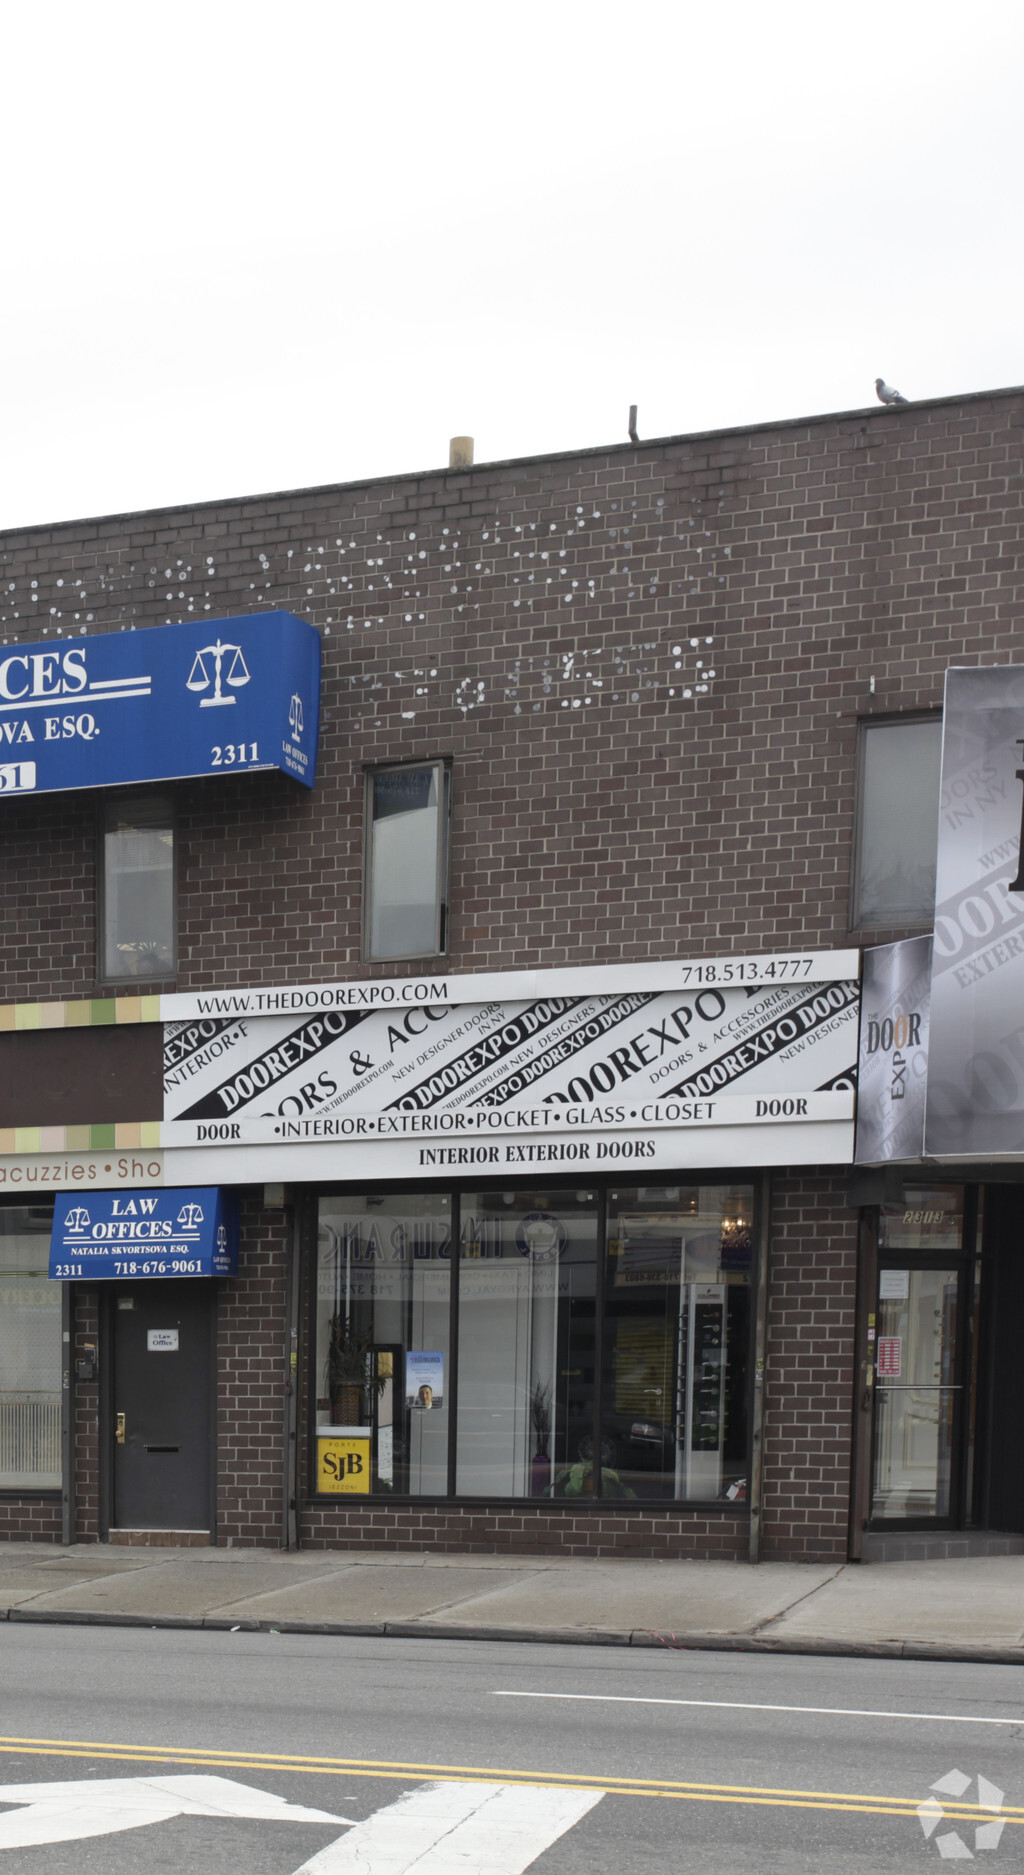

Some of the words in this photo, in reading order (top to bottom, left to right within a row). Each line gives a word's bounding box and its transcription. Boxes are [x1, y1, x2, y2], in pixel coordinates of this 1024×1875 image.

[44, 713, 101, 740] ESQ.
[211, 742, 260, 766] 2311
[682, 959, 814, 985] 718.513.4777
[197, 982, 449, 1013] WWW.THEDOOREXPO.COM
[478, 1022, 492, 1036] IN
[490, 1010, 507, 1029] NY
[510, 1044, 535, 1069] NEW
[538, 1004, 596, 1049] DESIGNERS
[649, 1050, 694, 1084] DOORS
[698, 1042, 709, 1052] &
[713, 986, 790, 1043] ACCESSORIES
[866, 1012, 922, 1054] DOOR
[392, 1061, 415, 1083] NEW
[417, 1027, 465, 1067] DESIGNER
[464, 1001, 502, 1032] DOORS
[524, 1022, 600, 1083] DOOREXPO
[779, 1040, 806, 1063] NEW
[217, 1009, 347, 1111] DOOREXPO
[349, 1050, 375, 1076] &
[415, 1024, 522, 1107] DOOREXPO
[680, 1019, 798, 1099] DOOREXPO
[196, 1124, 241, 1141] DOOR
[755, 1098, 808, 1117] DOOR
[419, 1147, 501, 1166] INTERIOR
[506, 1143, 590, 1163] EXTERIOR
[596, 1140, 656, 1159] DOORS
[111, 1198, 158, 1216] LAW
[904, 1211, 943, 1223] 2313
[92, 1220, 173, 1239] OFFICES
[71, 1247, 109, 1256] NATALIA
[111, 1245, 167, 1255] SKVORTSOVA
[170, 1244, 190, 1254] ESQ.
[55, 1264, 83, 1276] 2311
[114, 1260, 203, 1274] 718-676-9061
[323, 1452, 363, 1481] SJB
